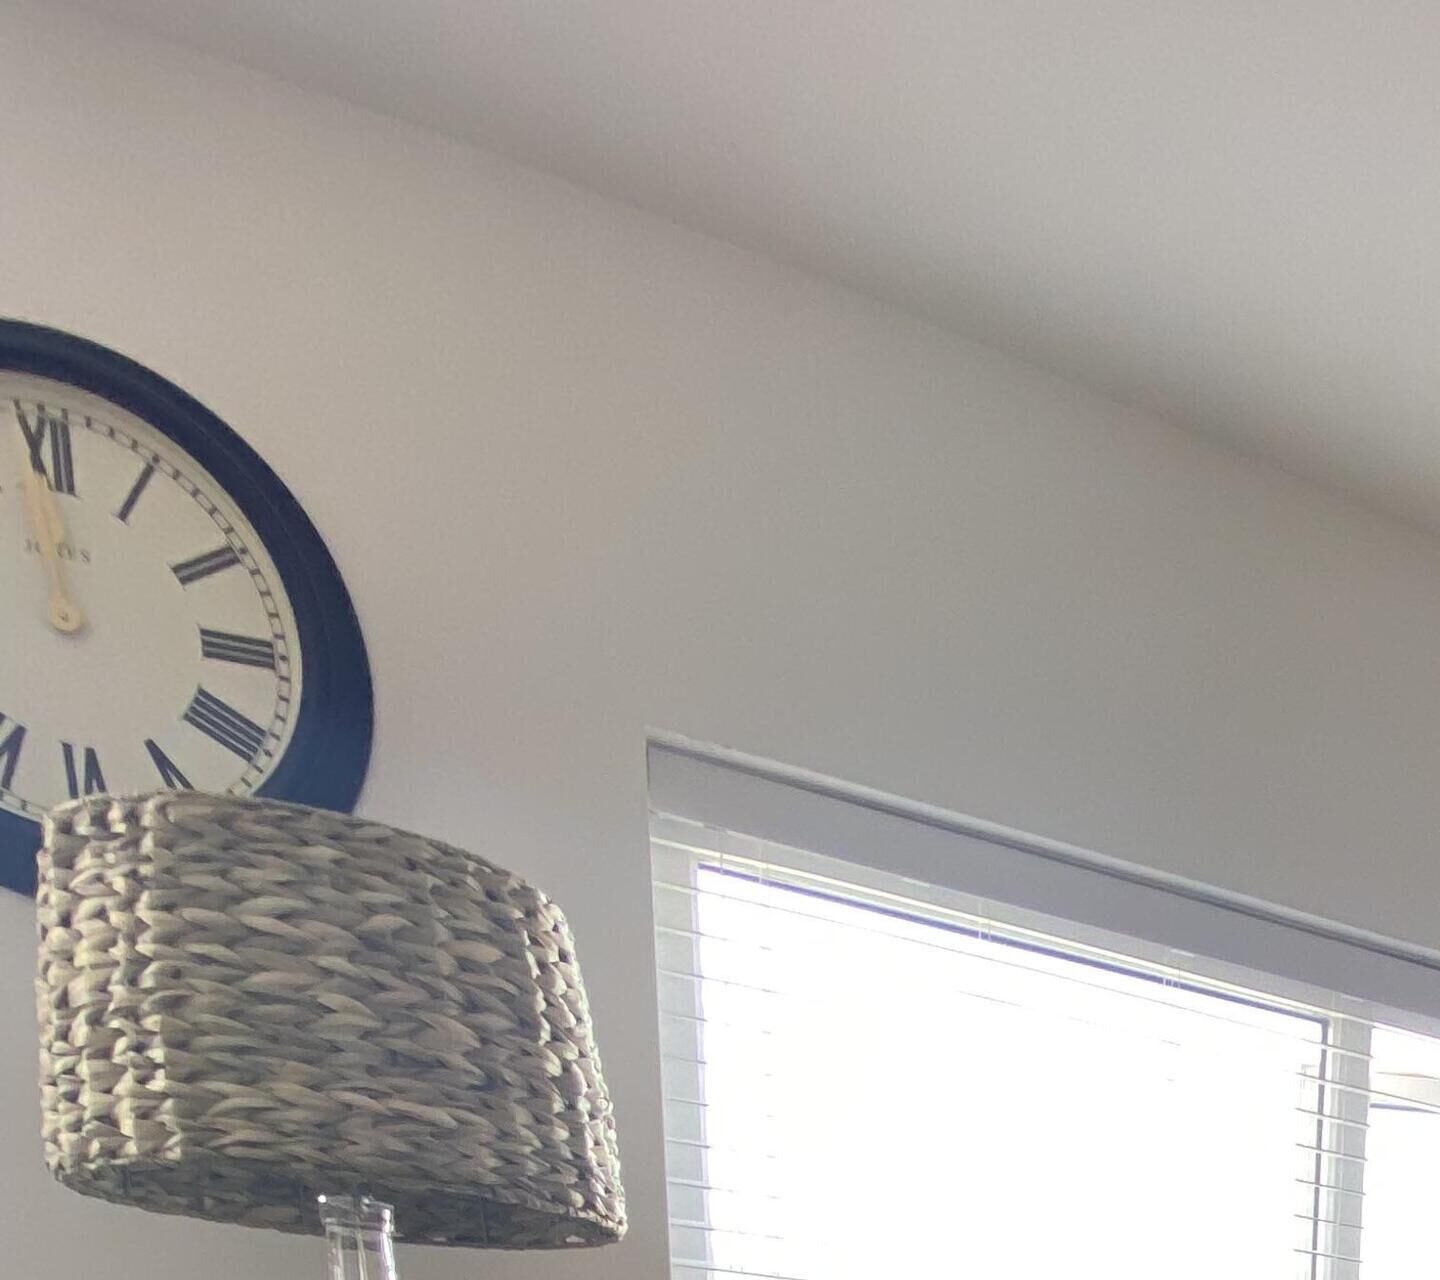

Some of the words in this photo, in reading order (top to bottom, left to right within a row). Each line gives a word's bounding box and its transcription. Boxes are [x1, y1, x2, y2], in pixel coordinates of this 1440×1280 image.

[13, 399, 80, 500] XII
[166, 540, 243, 591] II
[198, 623, 277, 670] III
[180, 683, 268, 762] IIII
